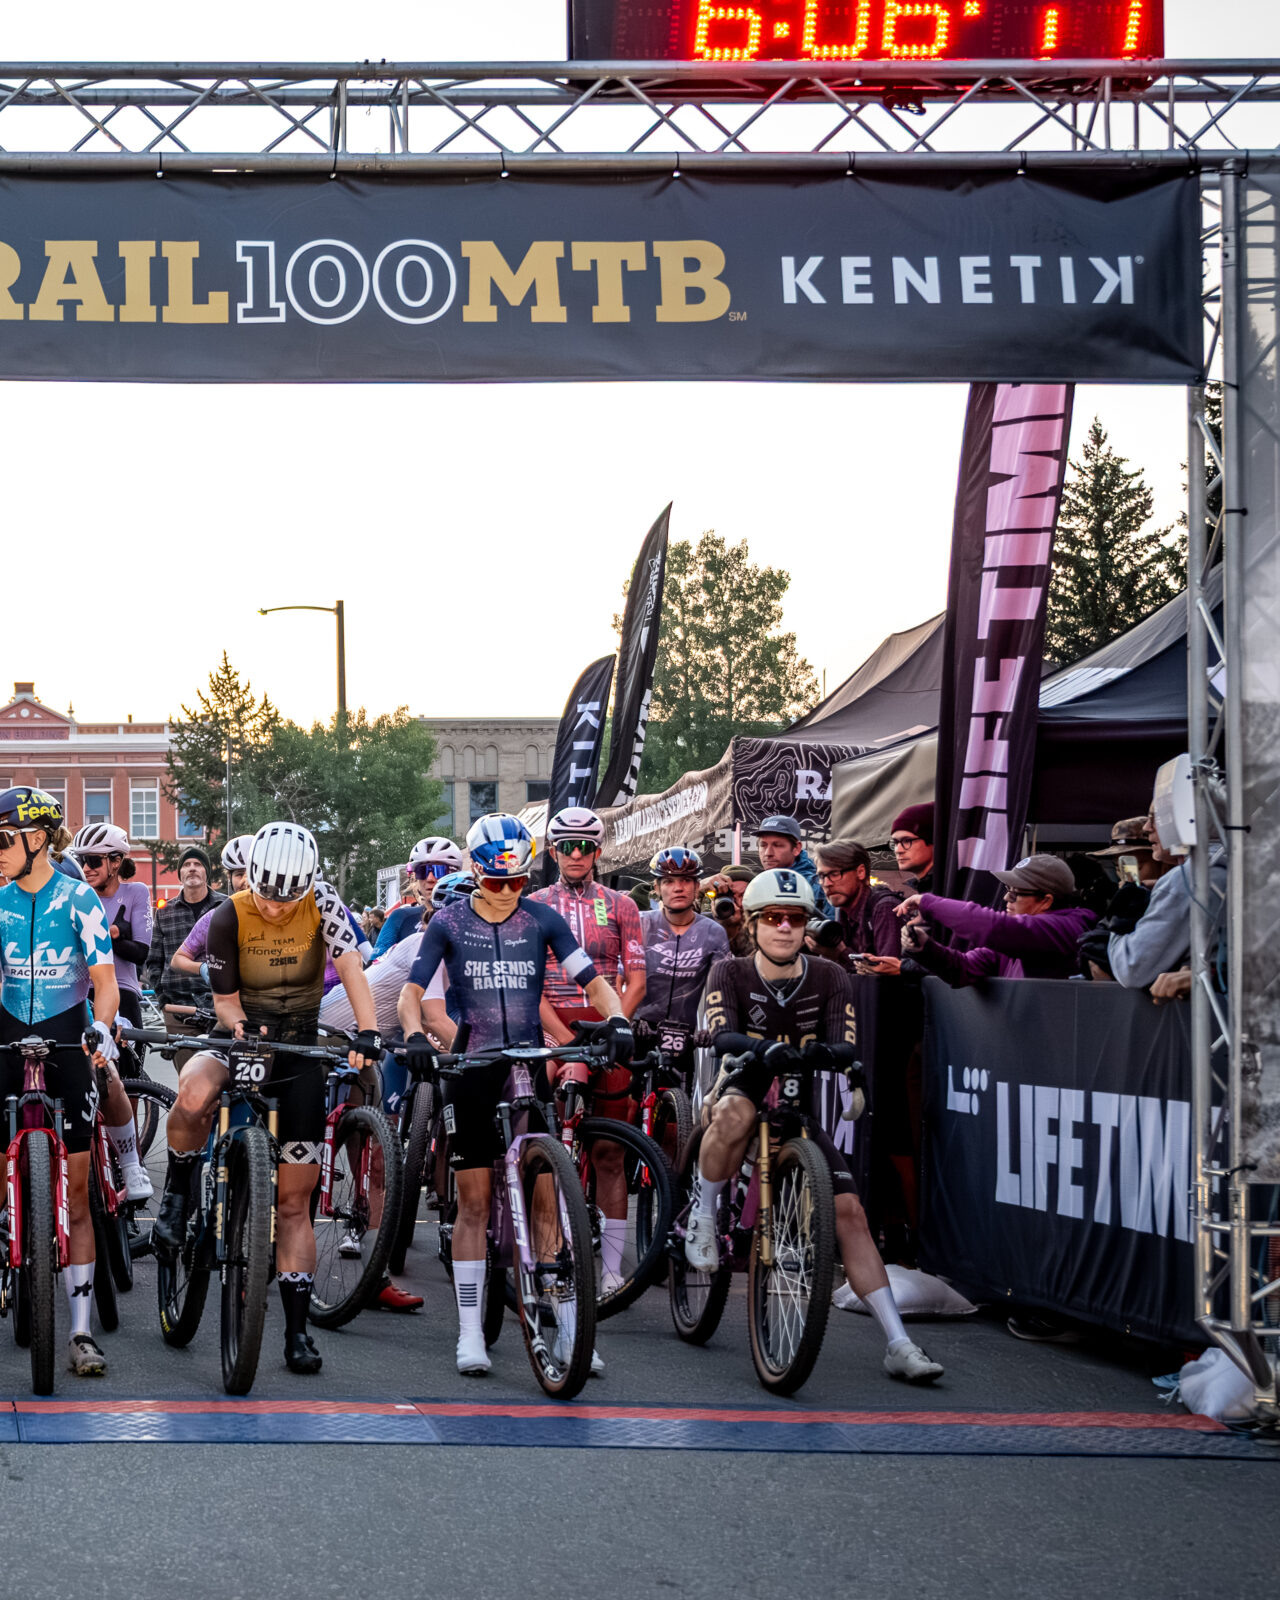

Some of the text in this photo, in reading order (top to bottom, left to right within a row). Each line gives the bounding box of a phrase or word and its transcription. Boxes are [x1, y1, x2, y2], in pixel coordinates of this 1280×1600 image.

[236, 239, 457, 325] 100
[461, 239, 731, 324] MTB
[781, 254, 1135, 305] KENETIK
[272, 937, 295, 945] TEAM
[651, 943, 703, 958] SANTA
[10, 968, 57, 977] RACING
[464, 959, 536, 977] SHE SENDS
[473, 975, 528, 990] RACING
[660, 1034, 684, 1051] 26
[235, 1062, 266, 1082] 20
[783, 1078, 799, 1097] 8
